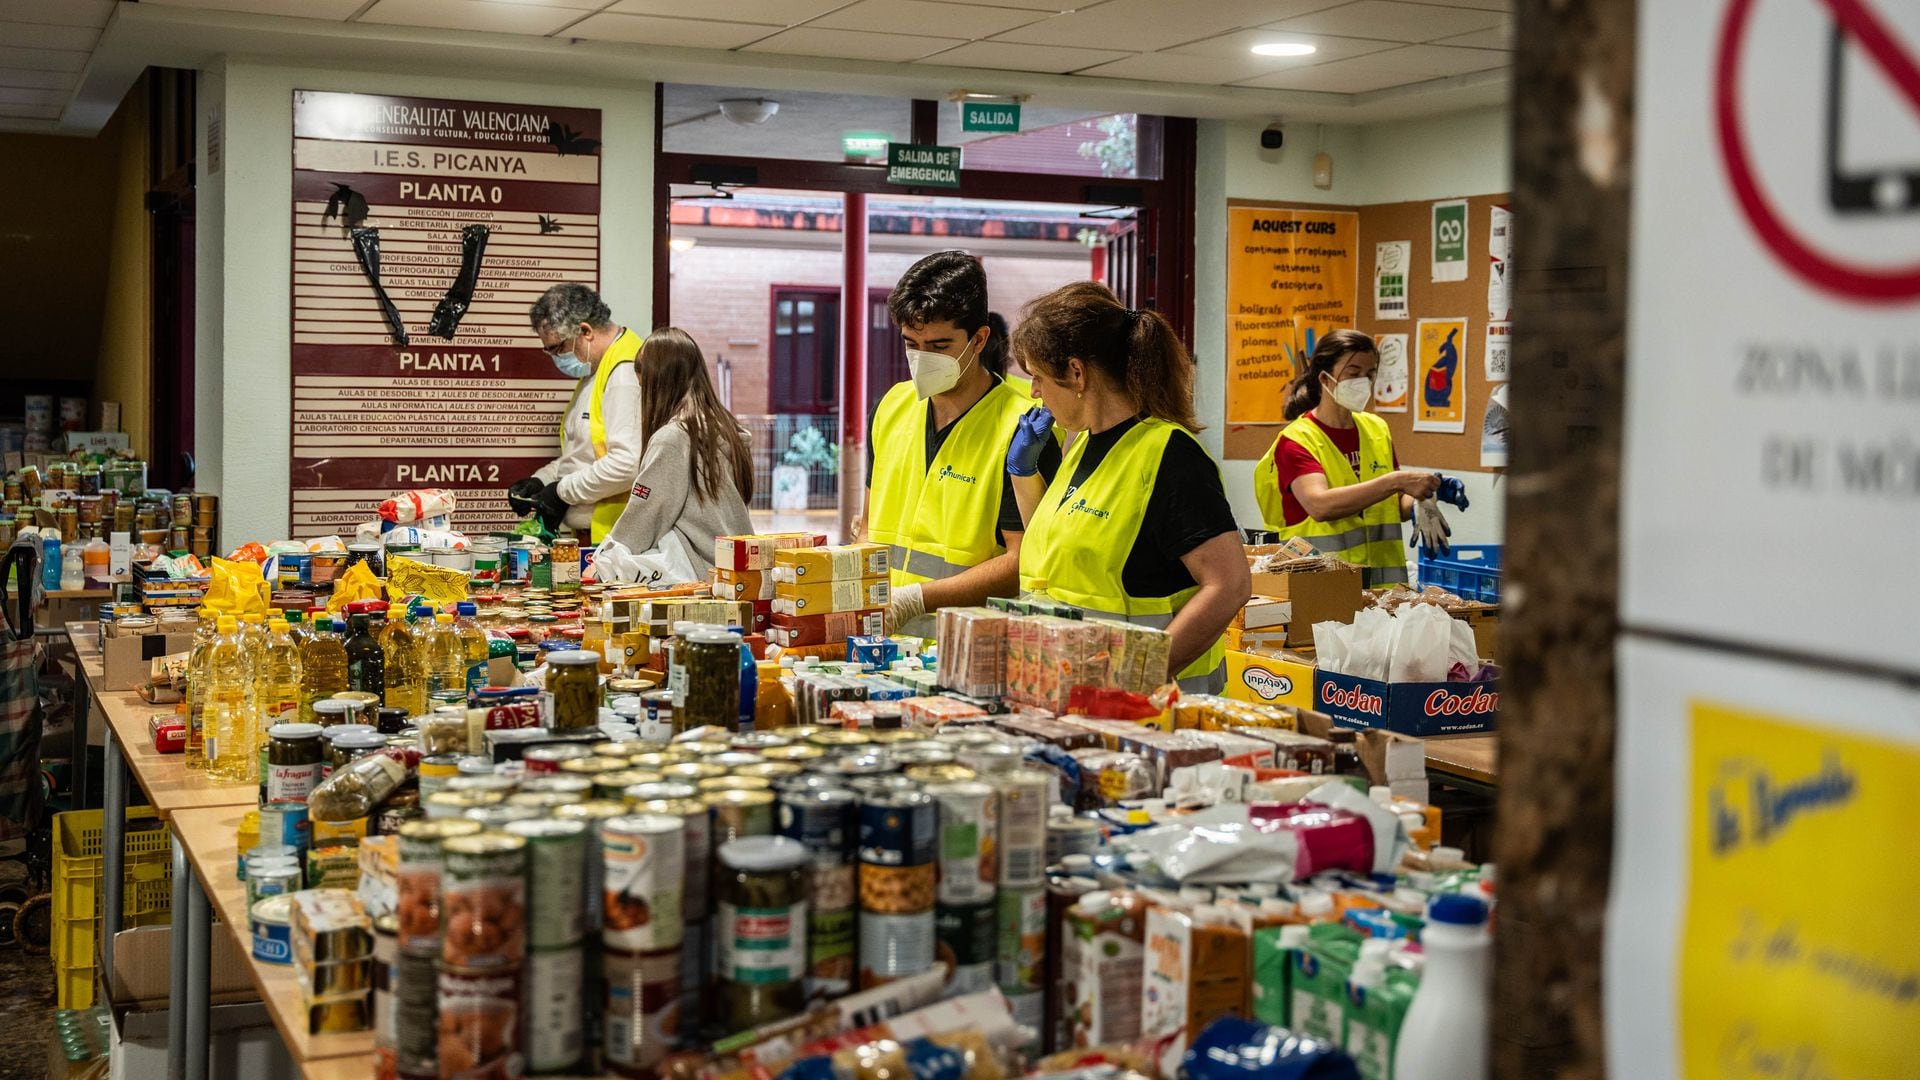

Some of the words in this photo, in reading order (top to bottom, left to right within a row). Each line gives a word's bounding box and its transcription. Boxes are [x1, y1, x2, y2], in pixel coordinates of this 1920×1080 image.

[364, 105, 456, 128] ENERALITAT
[463, 109, 550, 133] VALENCIANA
[969, 111, 1014, 125] SALIDA
[420, 128, 430, 137] DE
[434, 129, 471, 140] CULTURA,
[474, 131, 513, 142] EDUCACIÓ
[373, 149, 425, 169] I.E.S.
[434, 152, 527, 174] PICANYA
[898, 149, 934, 165] SALIDA
[936, 151, 950, 165] DE
[890, 167, 956, 183] EMERGENCIA
[400, 182, 485, 203] PLANTA
[490, 186, 502, 204] 0
[408, 208, 450, 218] DIRECCIÓN
[399, 219, 448, 229] SECRETARÍA
[1252, 219, 1302, 233] AQUEST
[1305, 221, 1336, 235] CURS
[427, 232, 448, 240] SALA
[427, 244, 461, 253] BIBLIOTE
[1244, 246, 1289, 254] continuem
[485, 258, 541, 267] PROFESSORAT
[388, 278, 415, 286] AULAS
[417, 279, 447, 287] TALLER
[481, 281, 510, 289] TALLER
[1235, 318, 1295, 331] fluorescents
[1241, 336, 1279, 349] plomes
[400, 352, 485, 372] PLANTA
[491, 354, 500, 372] 1
[1236, 353, 1283, 367] cartutxos
[1238, 368, 1289, 381] retoladors
[392, 378, 418, 386] AULAS
[433, 379, 450, 387] ESO
[338, 389, 365, 397] AULAS
[380, 390, 421, 398] DESDOBLE
[481, 391, 543, 399] DESDOBLAMENT
[390, 401, 444, 410] INFORMÁTICA
[449, 402, 475, 410] AULES
[299, 413, 326, 421] AULAS
[329, 413, 358, 421] TALLER
[361, 412, 407, 421] EDUCACIÓN
[408, 412, 445, 422] PLÁSTICA
[479, 414, 507, 422] TALLER
[508, 413, 554, 422] D'EDUCACIÓ
[299, 424, 358, 432] LABORATORIO
[360, 424, 397, 433] CIENCIAS
[399, 425, 446, 433] NATURALES
[451, 425, 501, 433] LABORATORI
[515, 425, 549, 433] CIÈNCIES
[397, 465, 483, 482] PLANTA
[487, 465, 500, 482] 2
[454, 501, 475, 509] ULES
[1247, 674, 1288, 692] Ketydul
[1321, 680, 1382, 716] Codan
[1333, 713, 1370, 727] www.codan.es
[1440, 722, 1484, 732] www.codan.es
